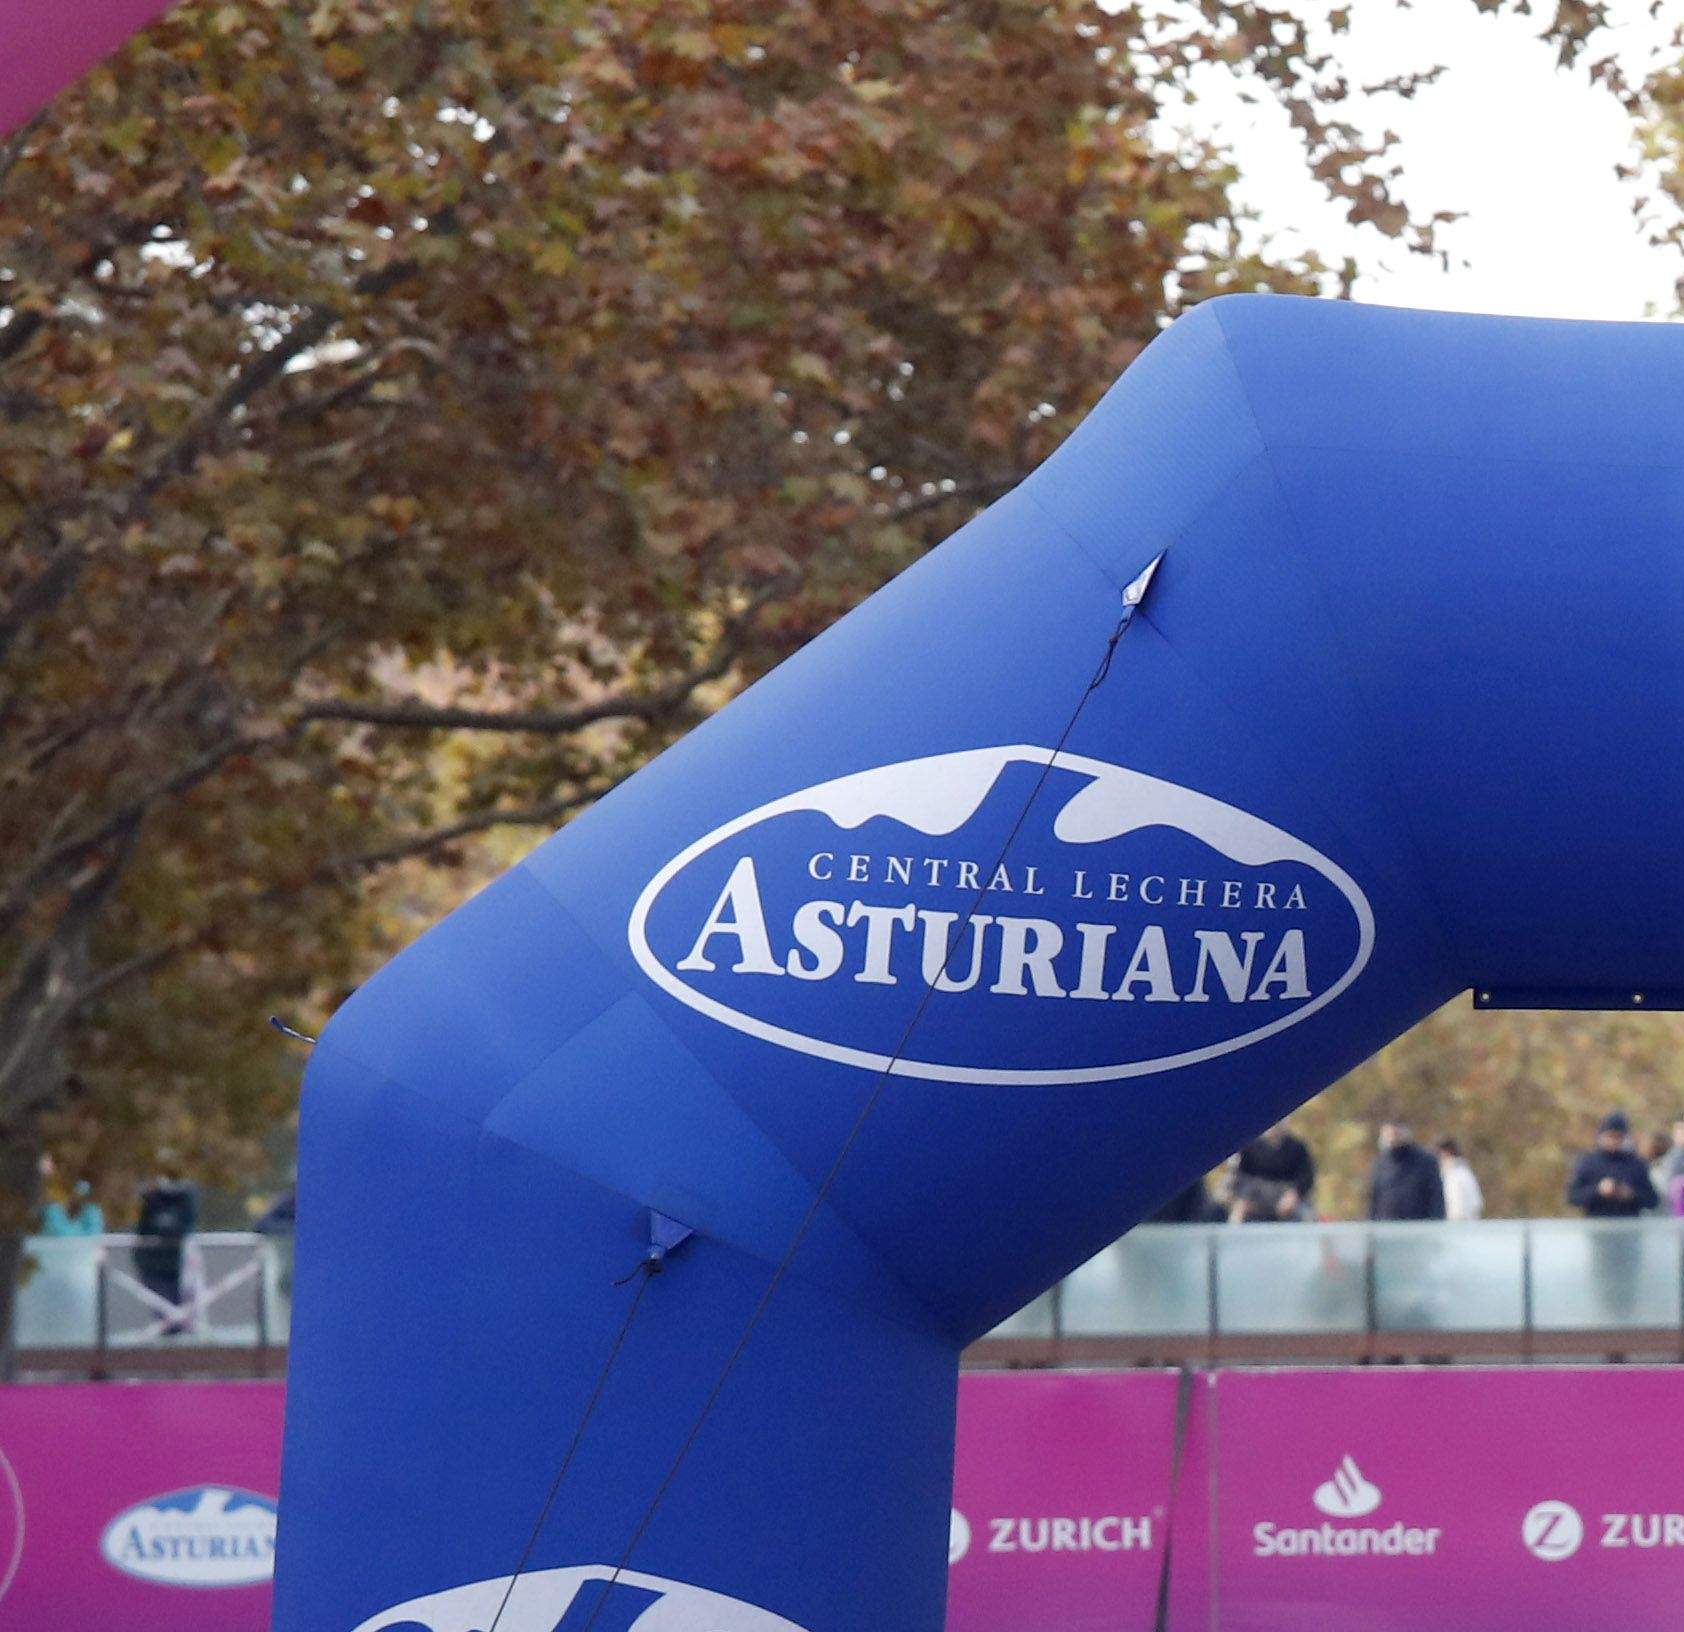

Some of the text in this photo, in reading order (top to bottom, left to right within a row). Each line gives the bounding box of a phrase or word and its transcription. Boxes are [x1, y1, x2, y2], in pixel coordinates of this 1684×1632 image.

[807, 851, 1310, 911] CENTRAL LECHERA
[676, 855, 1313, 1004] ASTURIANA
[121, 1524, 275, 1562] ASTURIA
[987, 1514, 1153, 1555] ZURICH
[1251, 1519, 1443, 1559] Santander
